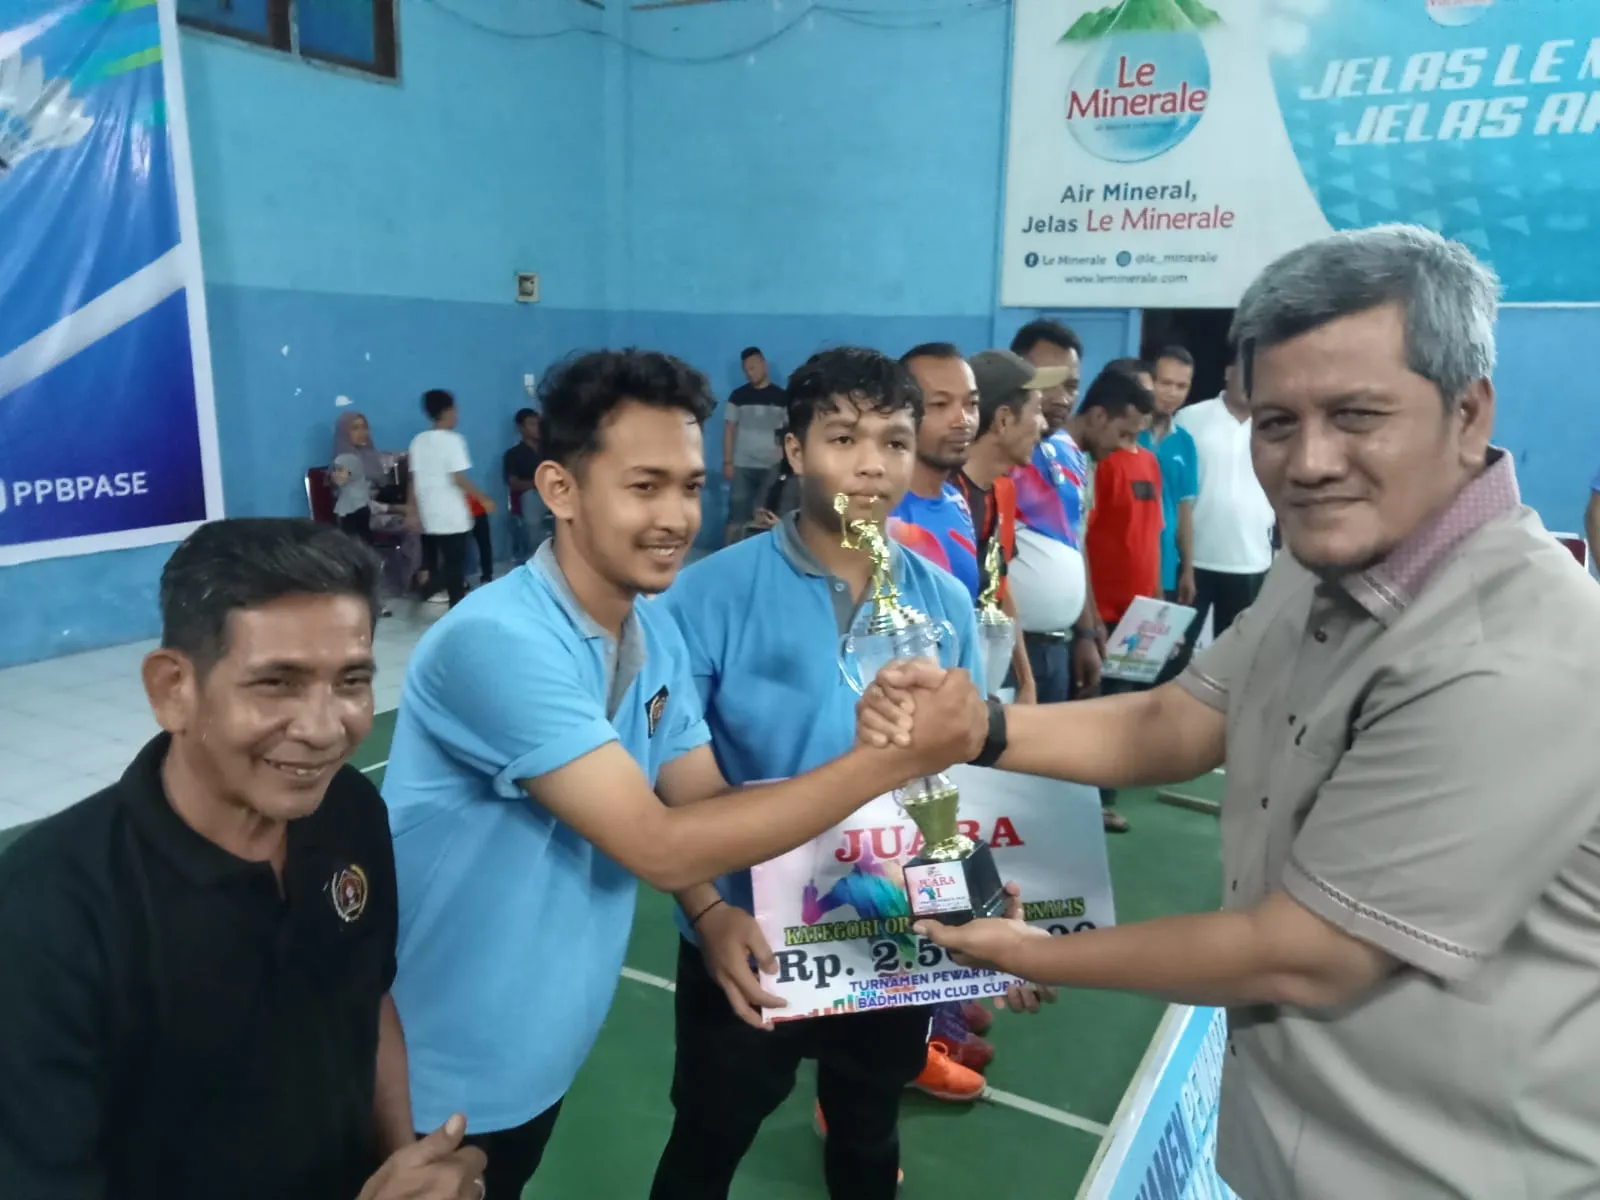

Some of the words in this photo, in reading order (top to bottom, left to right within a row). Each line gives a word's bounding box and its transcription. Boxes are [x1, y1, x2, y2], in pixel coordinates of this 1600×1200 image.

[1118, 56, 1156, 89] Le
[1299, 47, 1489, 101] JELAS
[1493, 39, 1575, 87] LE
[1066, 82, 1208, 120] Minerale
[1335, 96, 1529, 146] JELAS
[1060, 184, 1095, 204] Air
[1103, 180, 1198, 203] Mineral,
[1022, 216, 1078, 234] Jelas
[1087, 209, 1113, 232] Le
[1121, 205, 1235, 231] Minerale
[1042, 256, 1055, 266] Le
[1057, 254, 1107, 266] Minerale
[1135, 252, 1219, 265] @le_minerale
[1064, 274, 1190, 285] www.leminerale.com
[13, 471, 149, 506] PPBPASE
[785, 919, 879, 945] KATEGORI
[775, 949, 855, 988] Rp.
[849, 972, 931, 993] TURNAMEN
[858, 991, 940, 1009] BADMINTON
[945, 983, 979, 998] CLUB
